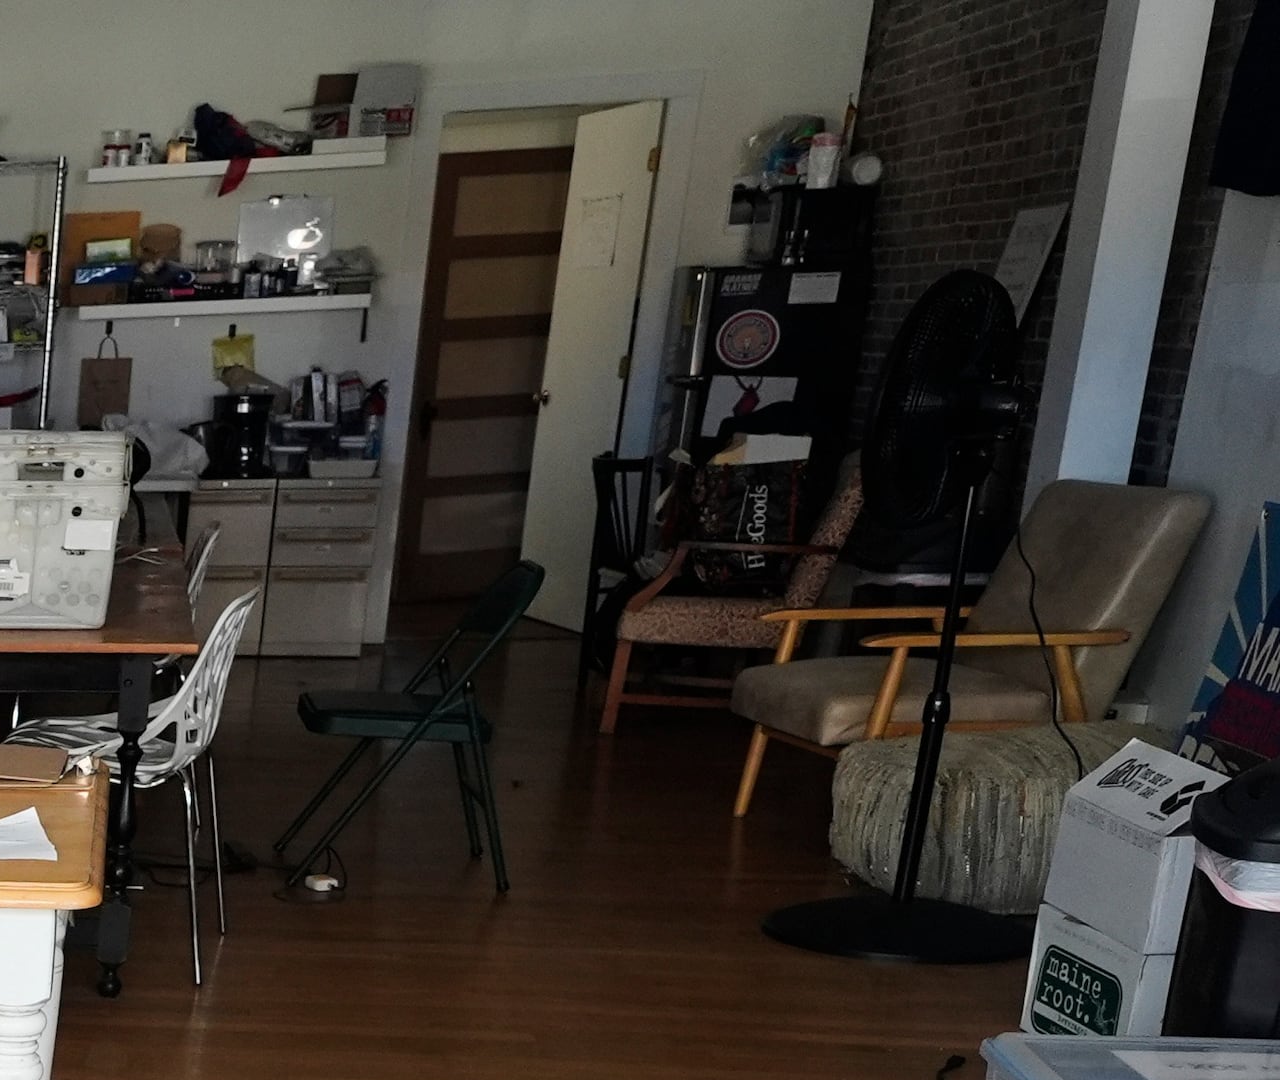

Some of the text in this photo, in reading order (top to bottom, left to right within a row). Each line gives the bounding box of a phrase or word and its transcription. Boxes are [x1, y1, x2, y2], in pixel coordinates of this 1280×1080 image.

[746, 484, 769, 569] HeGoods
[1046, 956, 1101, 999] maine
[1041, 981, 1090, 1024] root.
